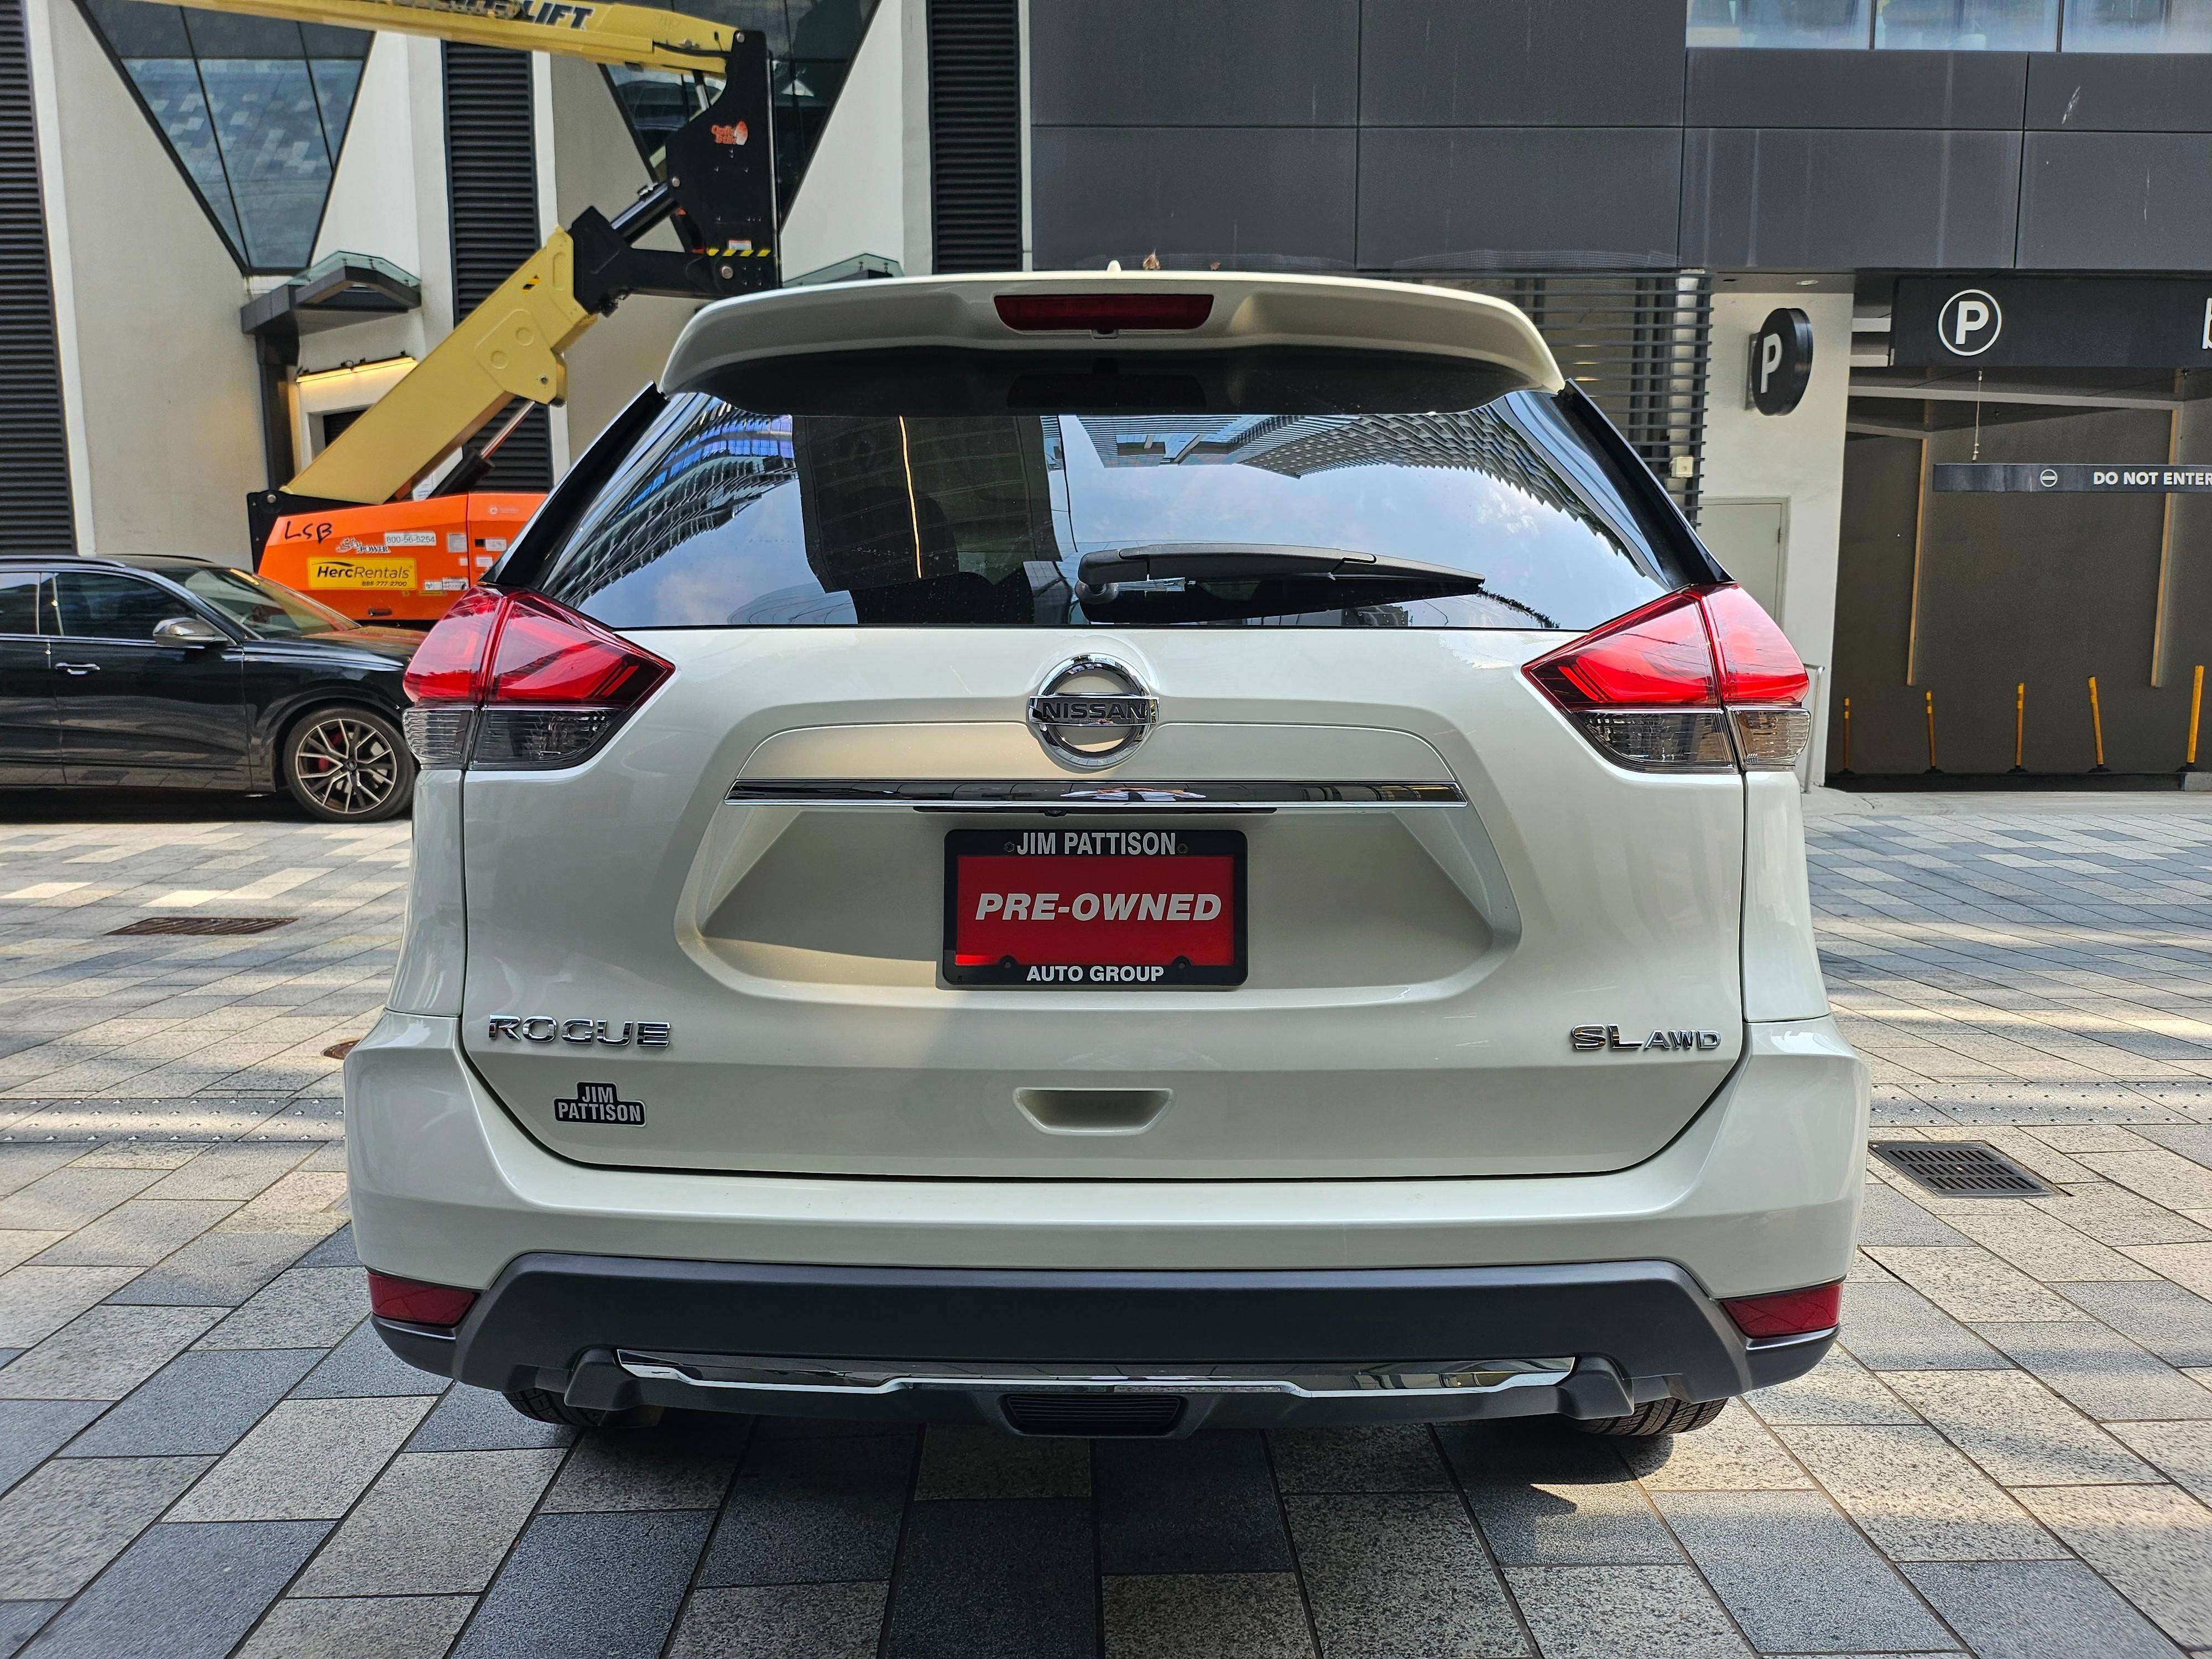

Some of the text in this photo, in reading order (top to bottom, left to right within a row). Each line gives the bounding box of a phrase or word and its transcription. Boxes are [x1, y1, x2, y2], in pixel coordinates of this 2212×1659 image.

[1955, 300, 1989, 345] P
[1760, 333, 1782, 394] P
[2093, 471, 2212, 486] DO NOT ENTER
[1042, 702, 1146, 720] NISSAN
[1016, 832, 1176, 855] JIM PATTISON
[975, 893, 1222, 921] PRE-OWNED
[1026, 966, 1165, 982] AUTO GROUP
[488, 1015, 671, 1047] ROGUE
[1571, 1023, 1722, 1050] SL AWD
[581, 1086, 614, 1103] JIM
[557, 1102, 641, 1122] PATTISON
